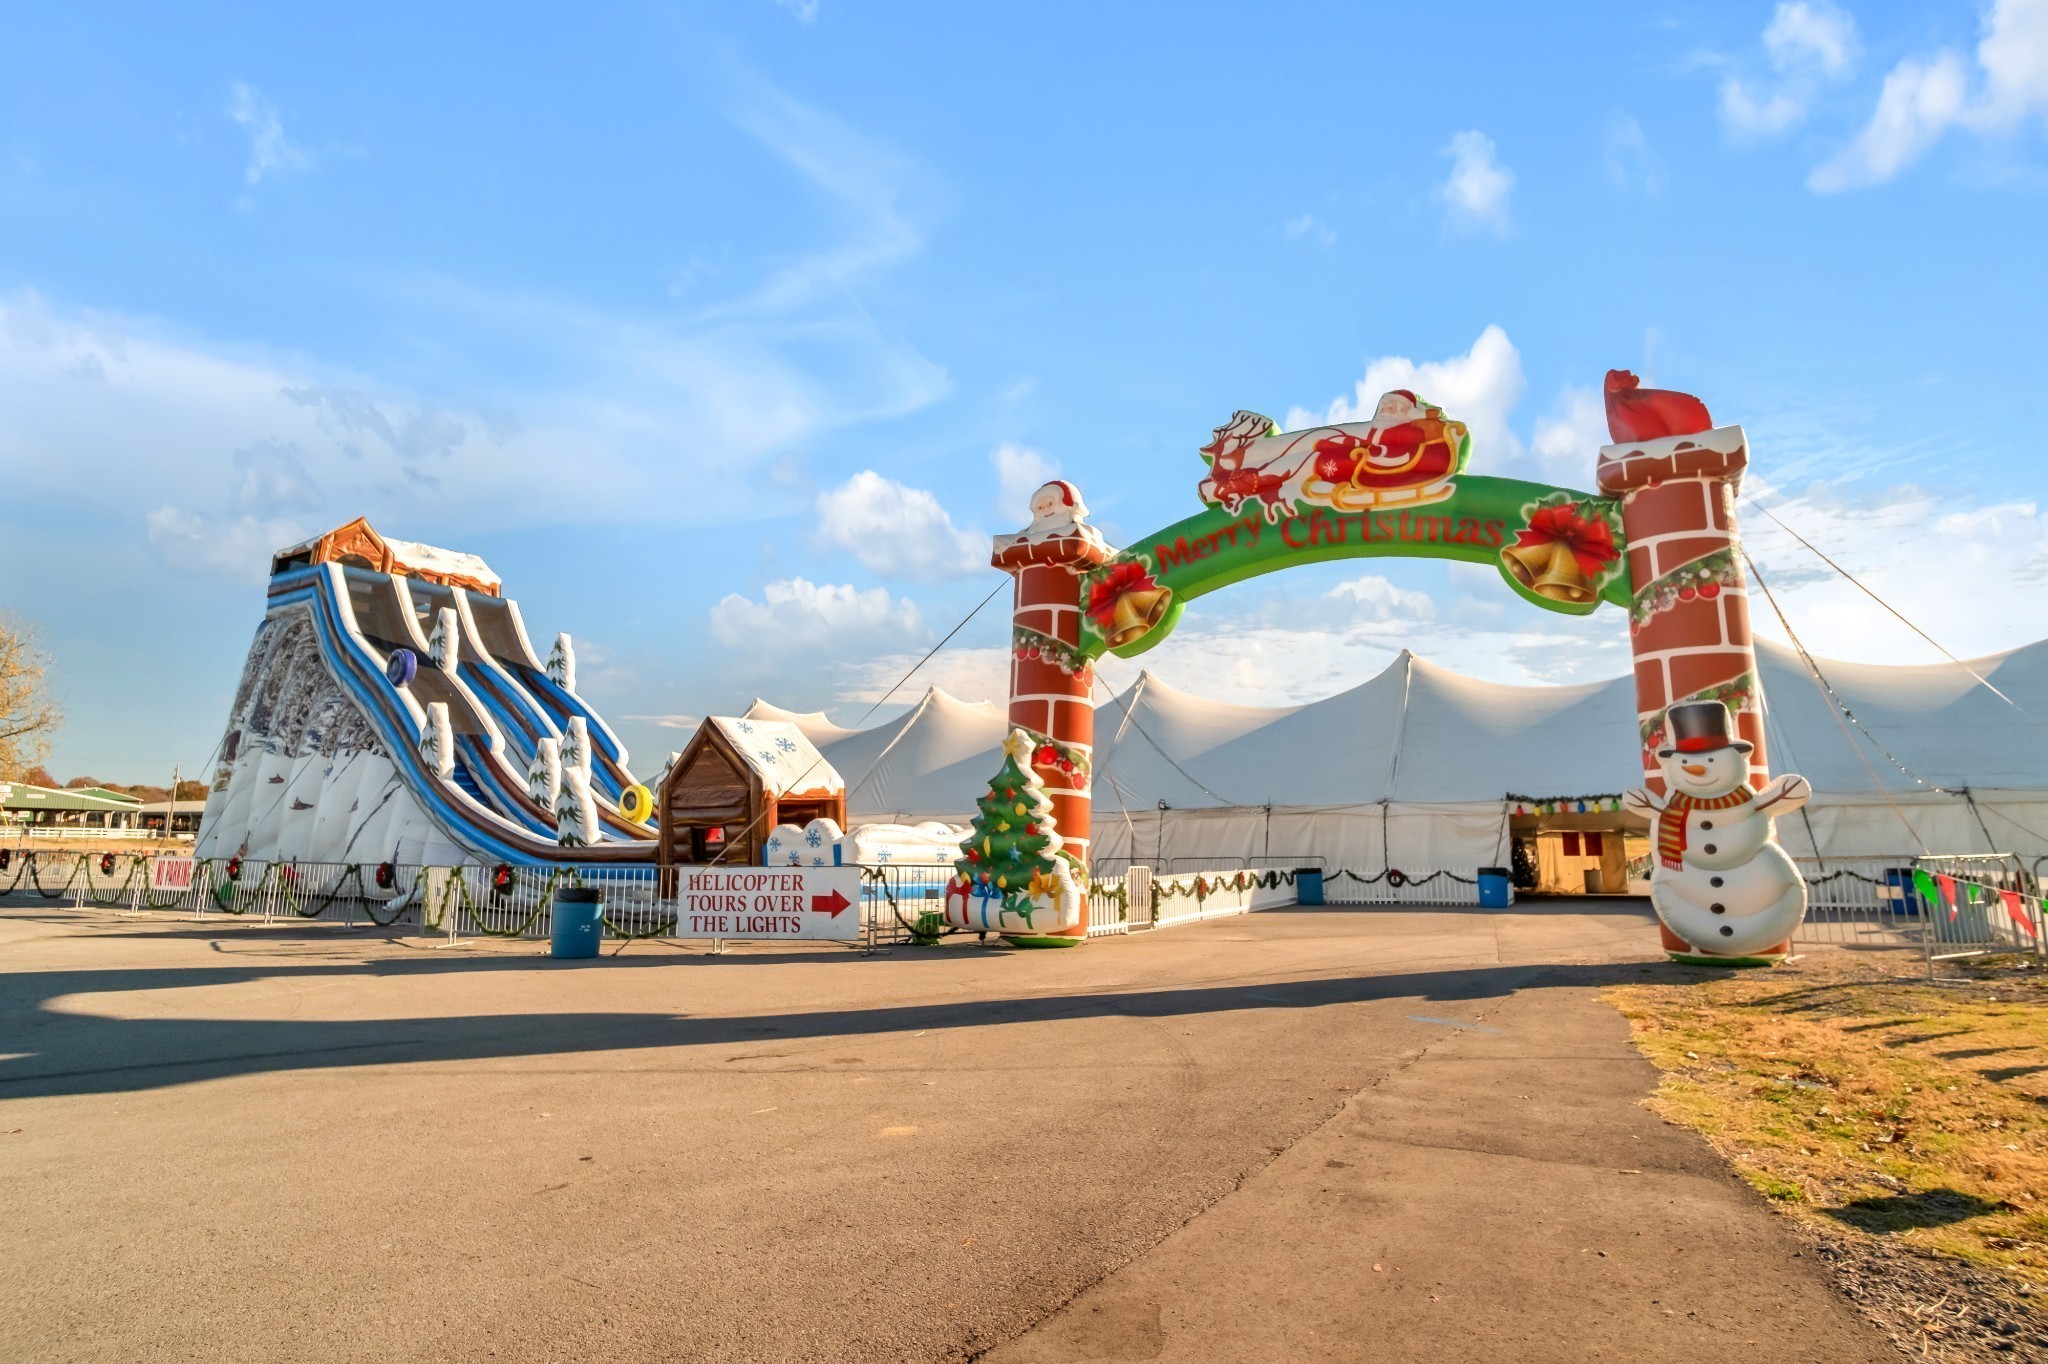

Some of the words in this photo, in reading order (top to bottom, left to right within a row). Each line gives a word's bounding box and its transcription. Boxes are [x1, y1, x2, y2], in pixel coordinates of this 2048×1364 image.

[1154, 511, 1262, 574] Merry
[1280, 508, 1506, 548] Christmas
[155, 860, 166, 886] NO
[165, 860, 192, 887] PARKING
[689, 874, 804, 892] HELICOPTER
[687, 895, 747, 912] TOURS
[754, 895, 805, 912] OVER
[690, 916, 729, 933] THE
[735, 916, 801, 934] LIGHTS
